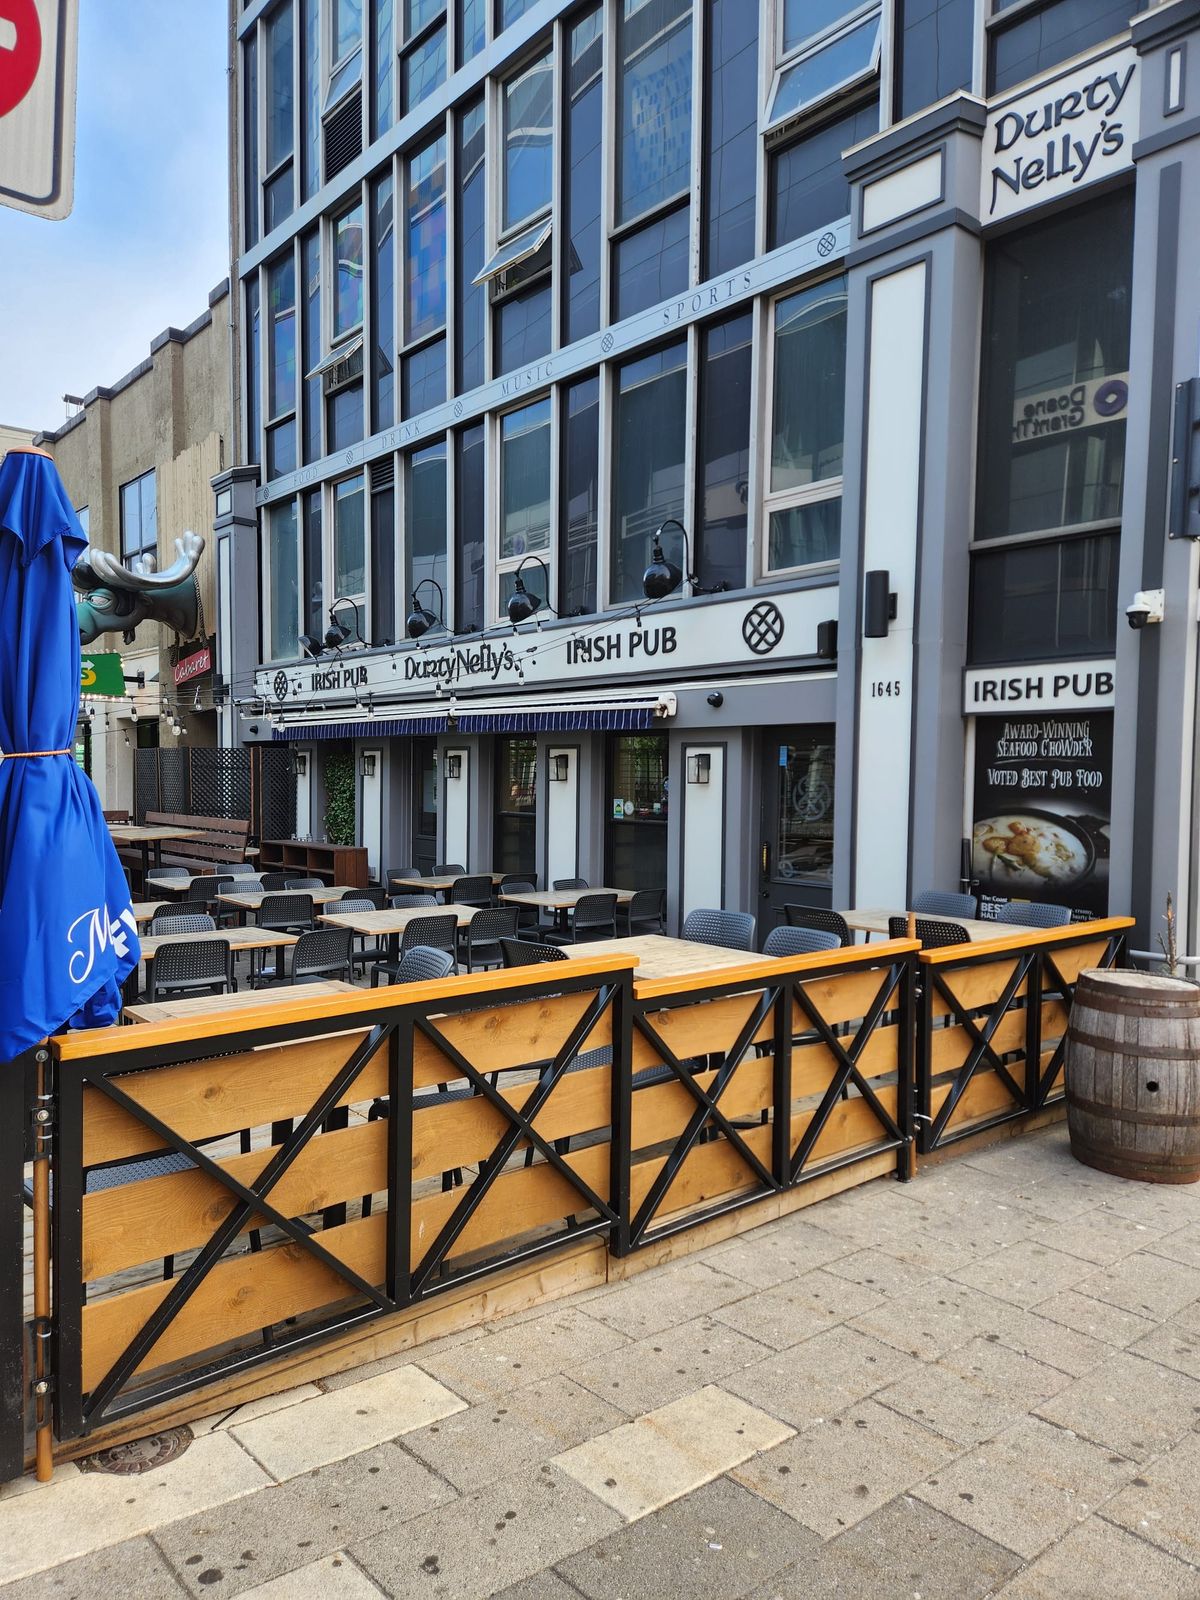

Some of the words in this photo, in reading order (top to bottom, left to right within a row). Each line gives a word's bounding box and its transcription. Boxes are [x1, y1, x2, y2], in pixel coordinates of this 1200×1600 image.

[990, 120, 1124, 215] Nelly's
[293, 465, 319, 487] FOOD
[382, 421, 420, 448] DRINK
[501, 361, 553, 396] MUSIC
[663, 271, 752, 325] SPORTS
[175, 651, 209, 682] Cabaret
[311, 670, 340, 691] IRISH
[344, 666, 368, 687] PUB
[567, 633, 621, 664] IRISH
[629, 626, 677, 658] PUB
[872, 680, 900, 697] 1645
[974, 677, 1043, 702] IRISH
[1053, 672, 1114, 698] PUB
[1002, 720, 1090, 739] AWARD-WINNING
[997, 739, 1037, 757] SEAFOOD
[1041, 738, 1093, 757] CHOWDER
[987, 768, 1018, 786] VOTED
[1021, 768, 1048, 788] BEST
[1051, 768, 1072, 789] PUB
[1076, 769, 1103, 787] FOOD
[981, 911, 998, 920] HALI
